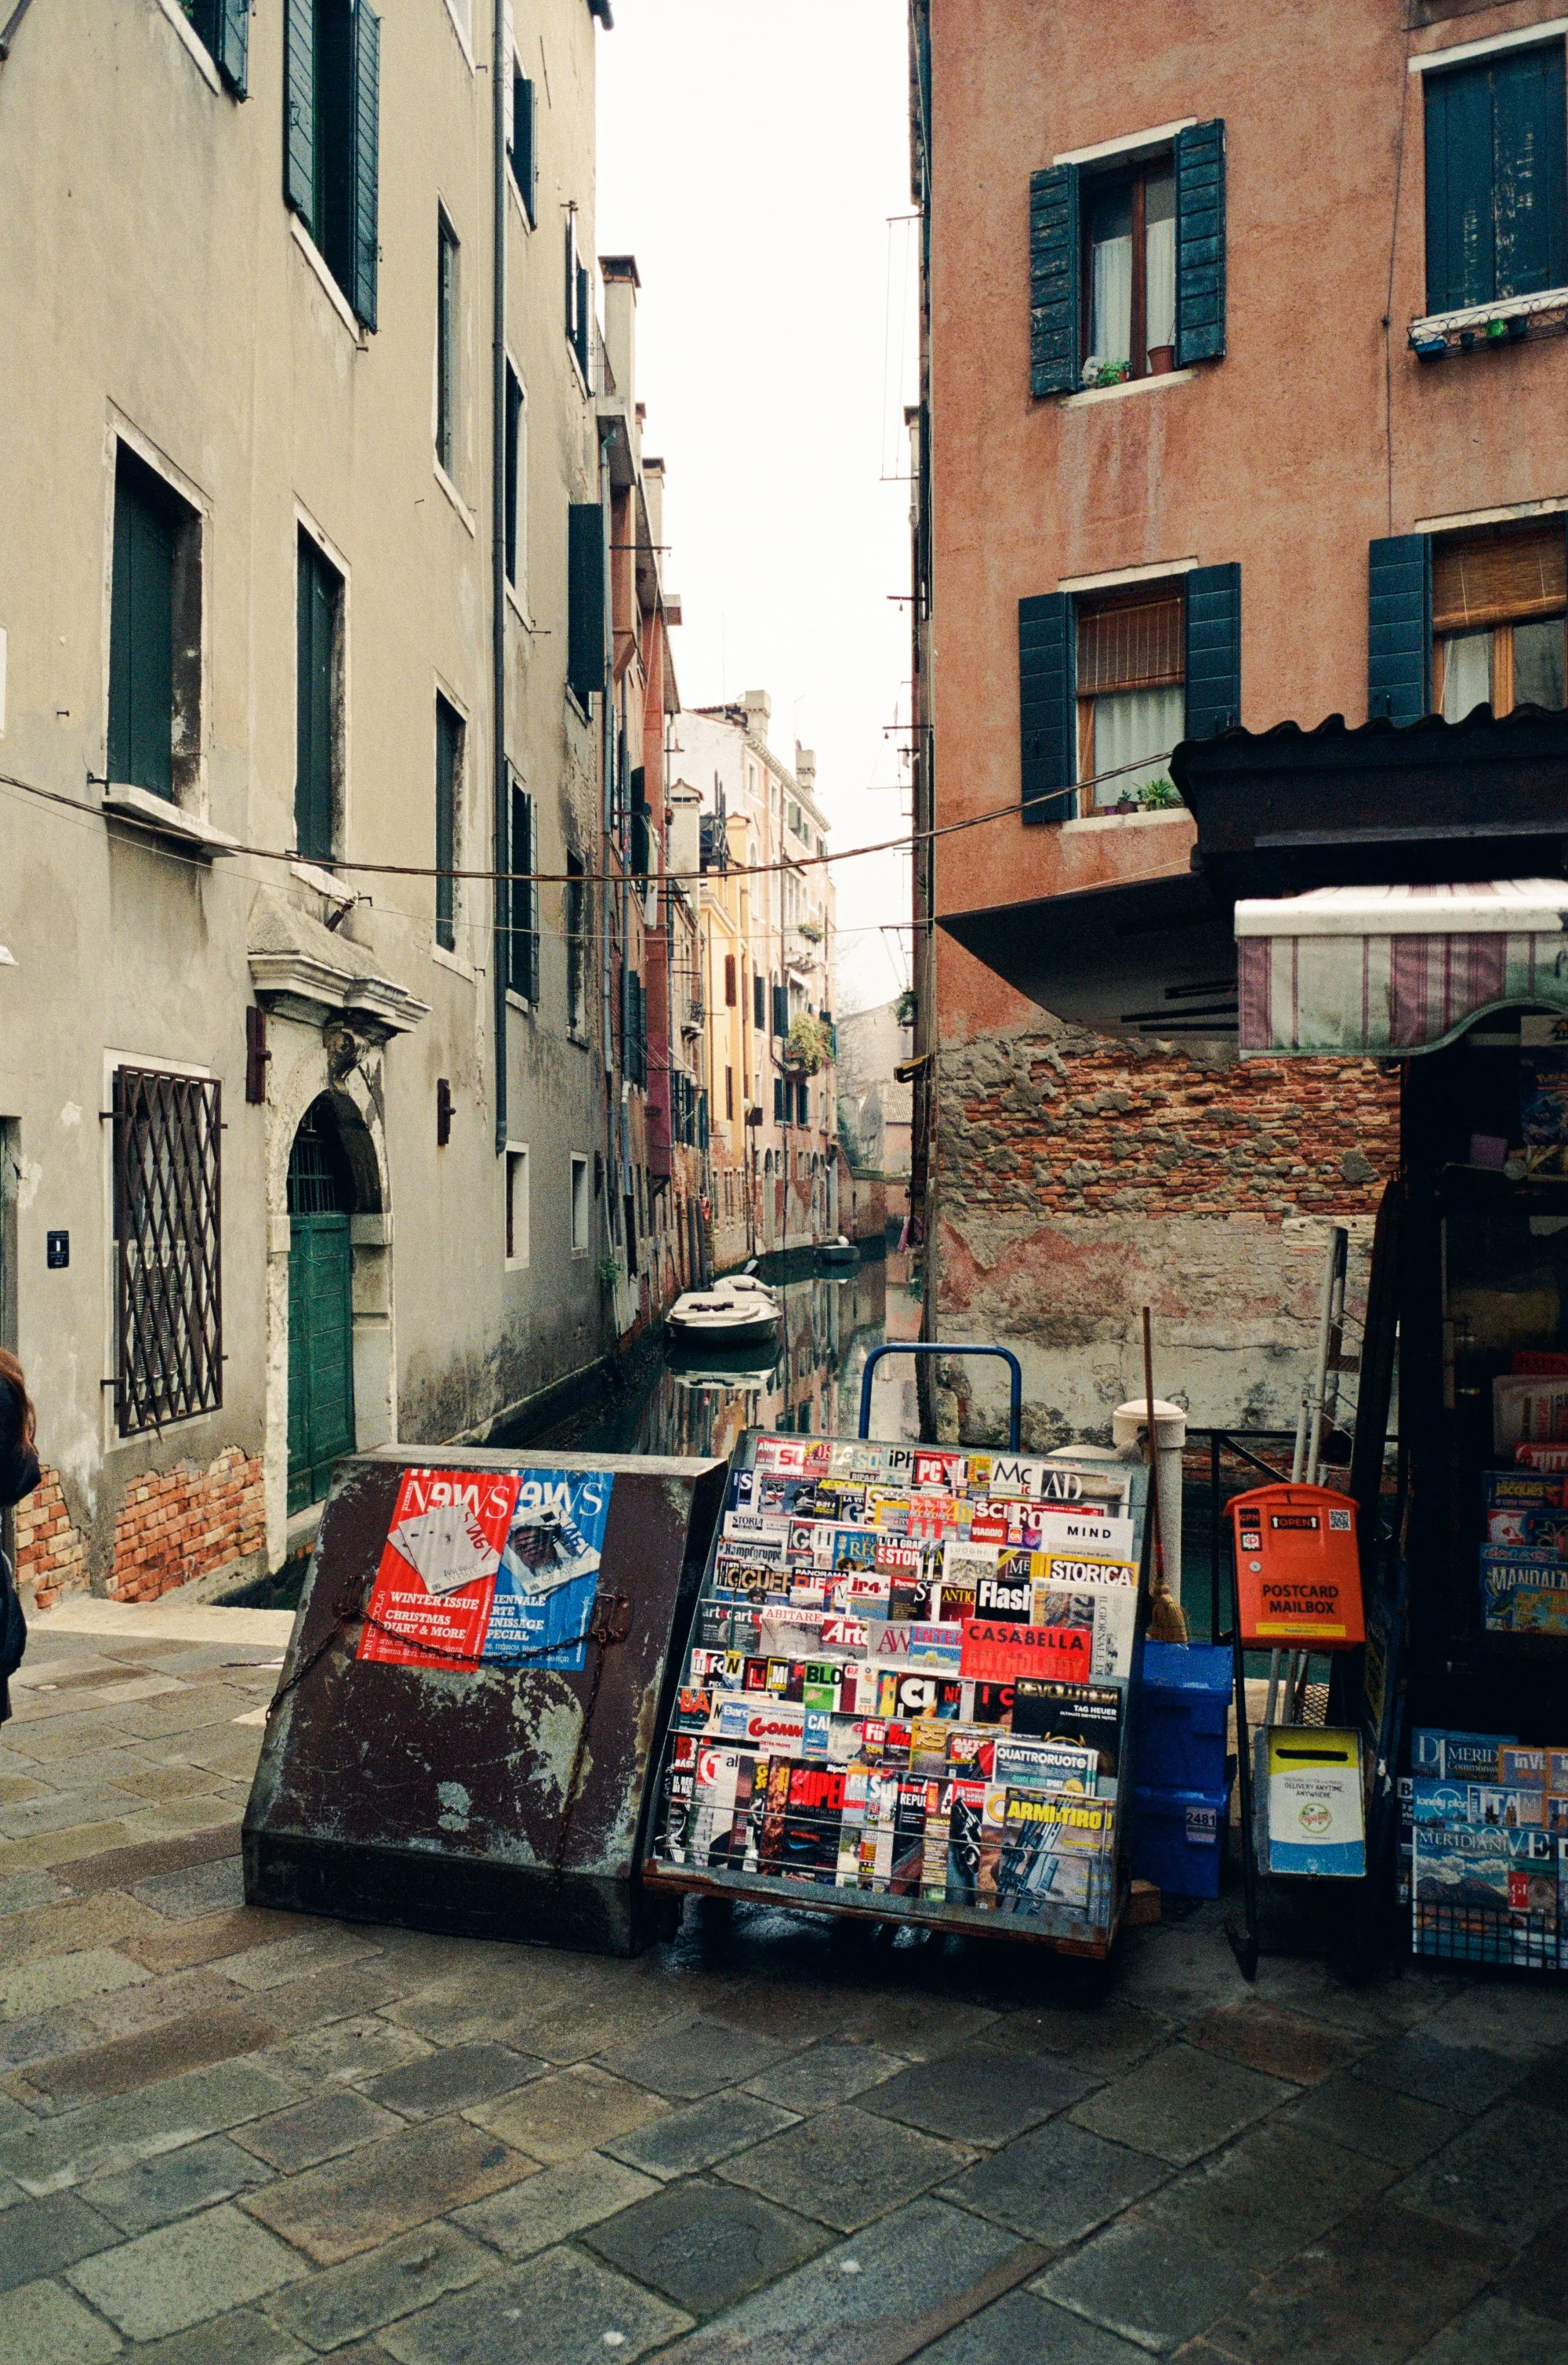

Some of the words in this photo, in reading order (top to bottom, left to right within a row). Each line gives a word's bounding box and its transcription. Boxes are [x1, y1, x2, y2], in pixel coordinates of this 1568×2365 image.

[1044, 1471, 1083, 1499] AD
[1279, 1517, 1310, 1527] OPEN
[1067, 1525, 1112, 1539] MIND
[796, 1569, 848, 1579] PANORAMA
[1051, 1560, 1132, 1586] STORICA
[1263, 1584, 1339, 1598] POSTCARD
[390, 1591, 443, 1606] WINTER
[443, 1597, 479, 1611] ISSUE
[493, 1594, 546, 1607] IENNALE
[1269, 1600, 1335, 1615] MAILBOX
[385, 1609, 452, 1626] CHRISTMAS
[766, 1608, 822, 1622] ABITARE
[384, 1621, 419, 1634] DIARY
[419, 1625, 429, 1636] &
[430, 1626, 466, 1640] MORE
[489, 1617, 545, 1630] INISSAGE
[485, 1629, 530, 1641] PECIAL
[969, 1626, 1084, 1651] CASABELLA
[364, 1638, 374, 1651] IN
[1074, 1705, 1090, 1713] TAG
[1091, 1706, 1116, 1716] HEUER
[1296, 1790, 1331, 1799] ANYWHERE
[1007, 1800, 1055, 1823] ARMI
[1061, 1808, 1102, 1829] TIRO
[1186, 1812, 1215, 1826] 2481
